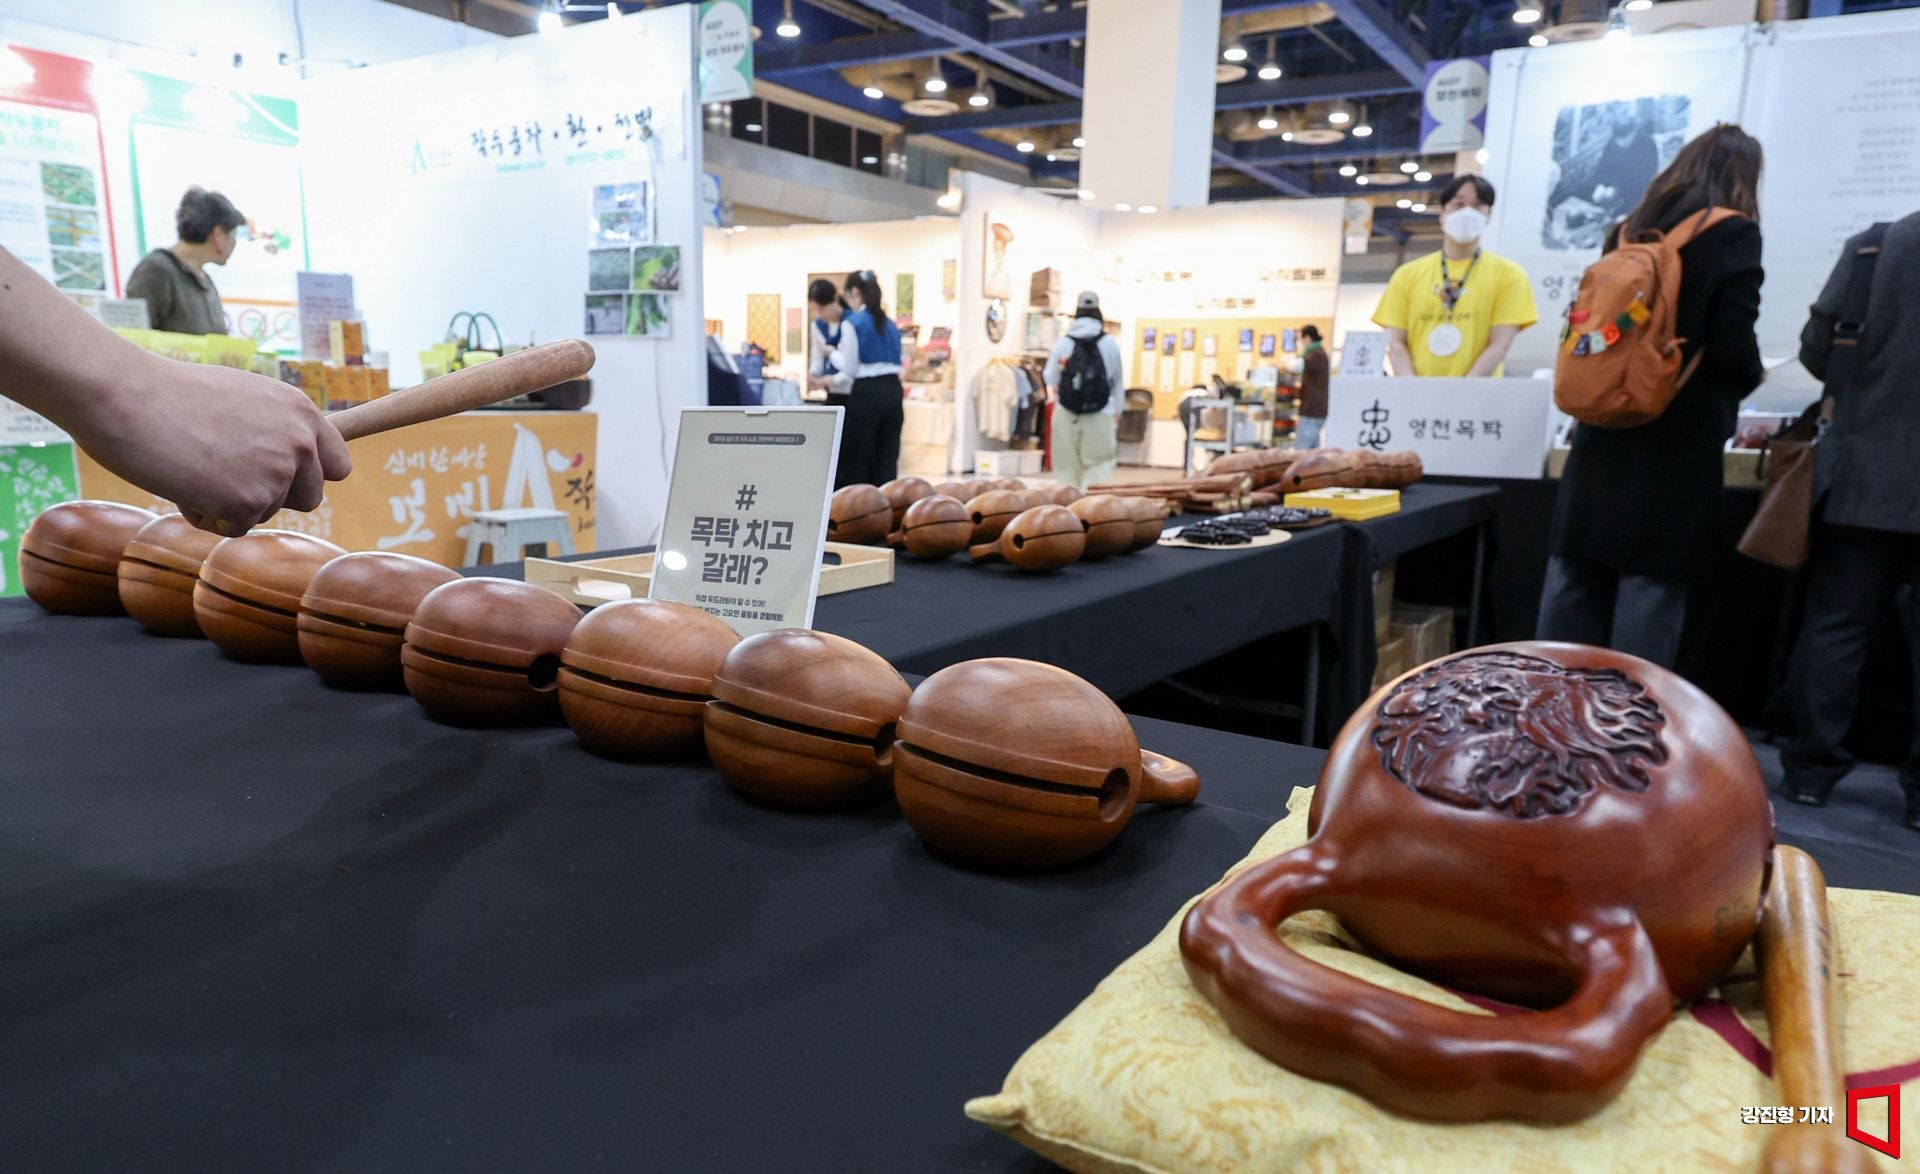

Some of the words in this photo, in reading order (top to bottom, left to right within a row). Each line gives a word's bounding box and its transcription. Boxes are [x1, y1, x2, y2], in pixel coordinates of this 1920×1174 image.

[735, 484, 758, 511] #
[691, 516, 740, 548] 목탁
[742, 519, 794, 551] 치고
[702, 553, 769, 585] 갈래?
[695, 594, 707, 603] 직접
[744, 598, 751, 606] 수
[722, 608, 740, 618] 고요한
